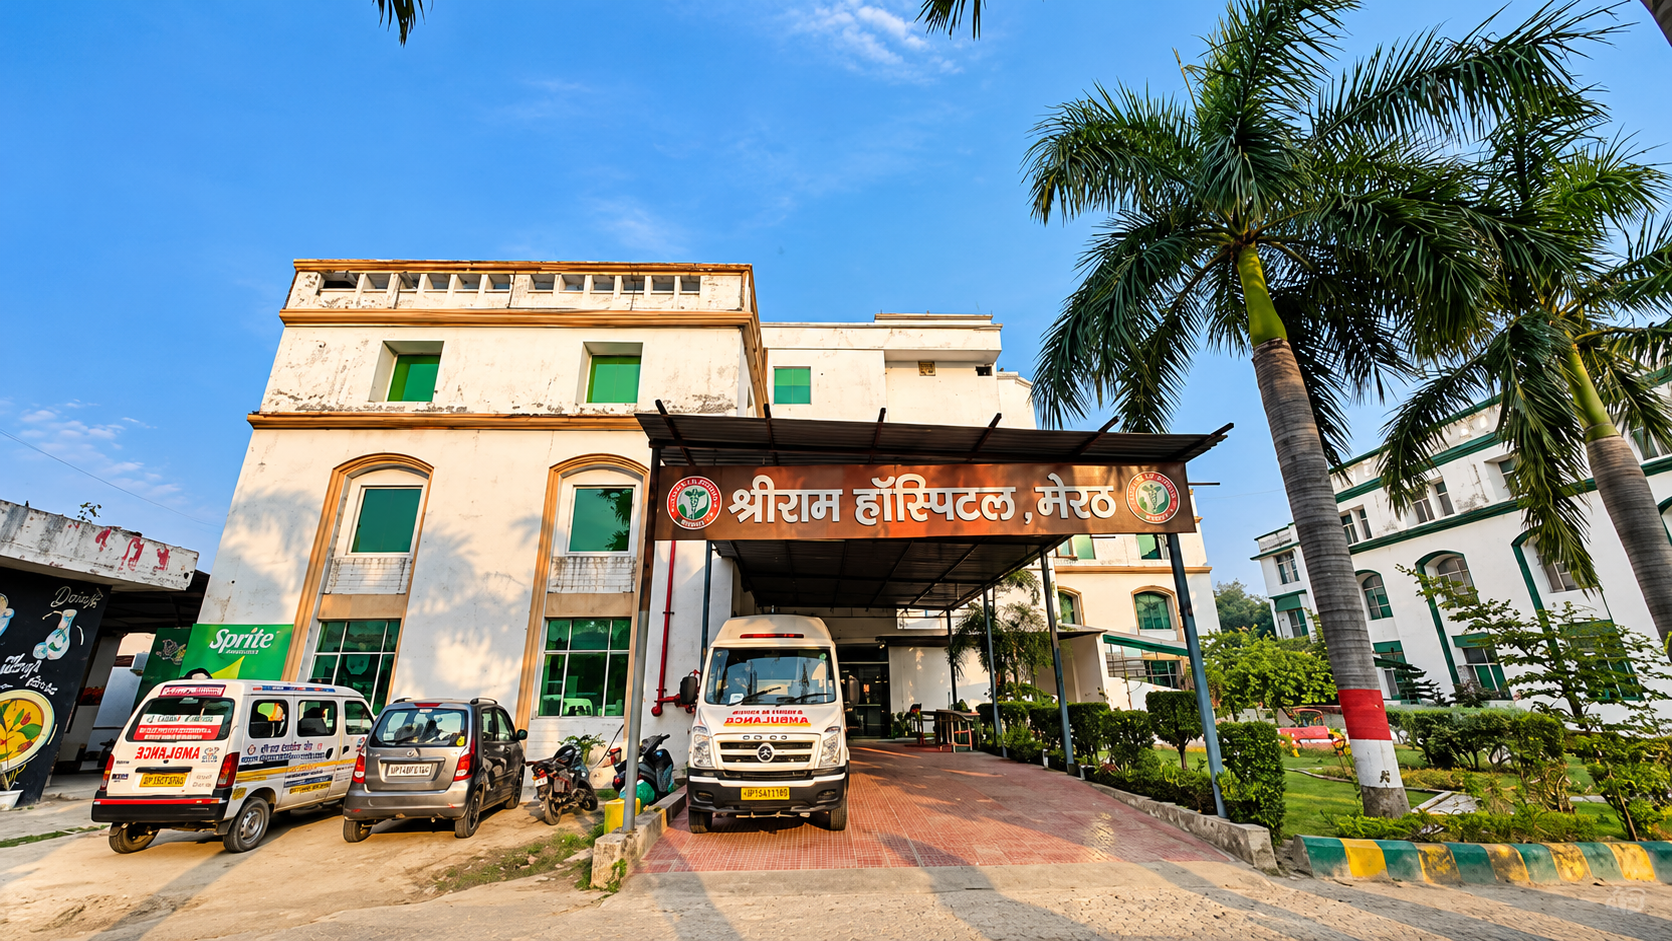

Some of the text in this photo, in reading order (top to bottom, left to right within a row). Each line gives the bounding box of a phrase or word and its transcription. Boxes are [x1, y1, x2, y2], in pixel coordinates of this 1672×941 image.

[727, 474, 843, 523] श्रीराम
[852, 473, 1016, 526] हॉस्पिटल
[209, 627, 275, 654] Sprite
